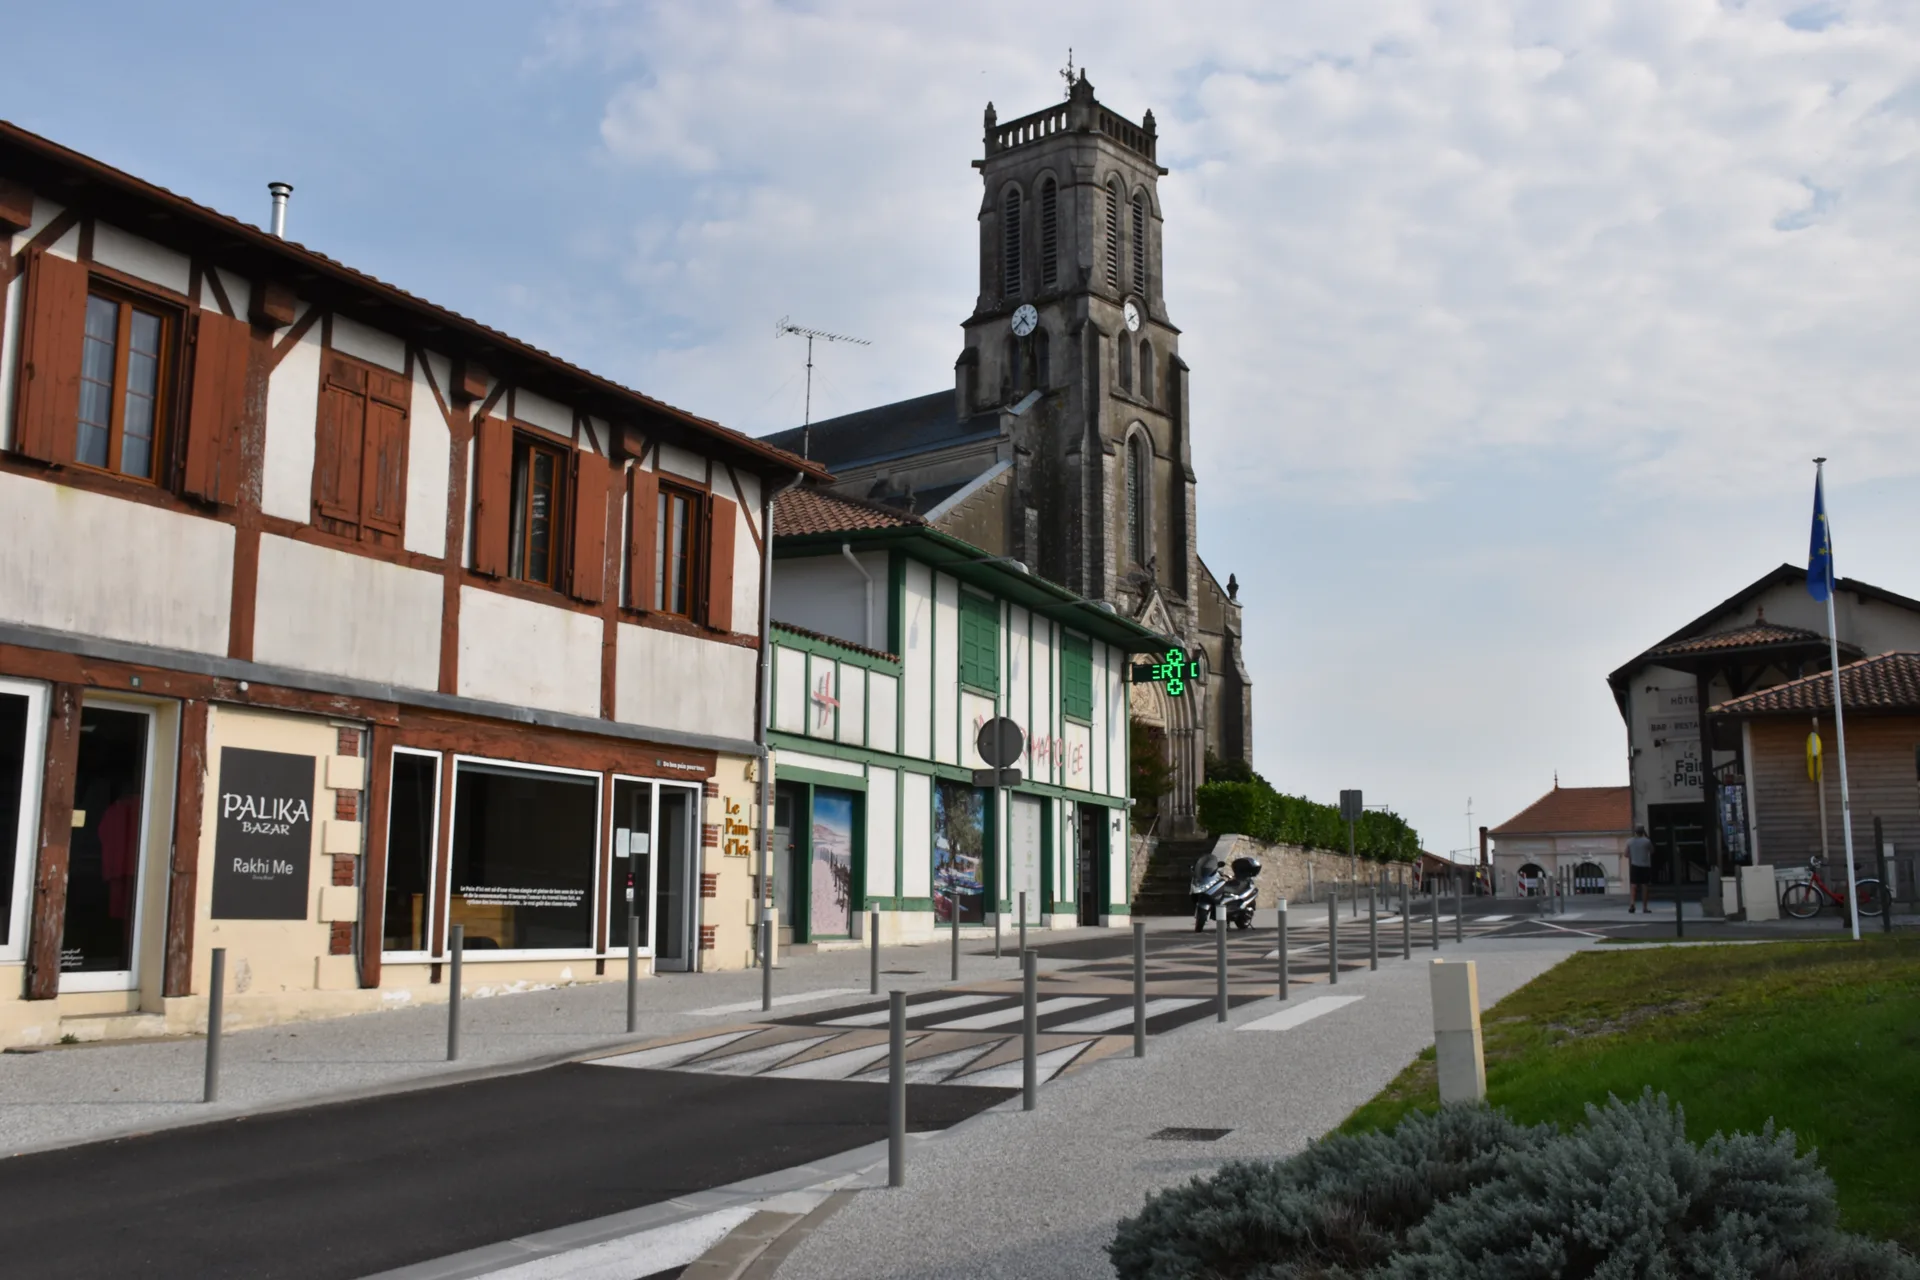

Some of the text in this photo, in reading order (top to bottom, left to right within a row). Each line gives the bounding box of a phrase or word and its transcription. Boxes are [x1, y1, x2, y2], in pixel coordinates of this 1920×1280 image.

[1674, 721, 1700, 730] RESTA
[223, 793, 310, 824] PALIKA
[725, 797, 740, 815] Le
[242, 821, 290, 835] BAZAR
[725, 818, 748, 835] Pain
[233, 858, 294, 875] Rakhi Me
